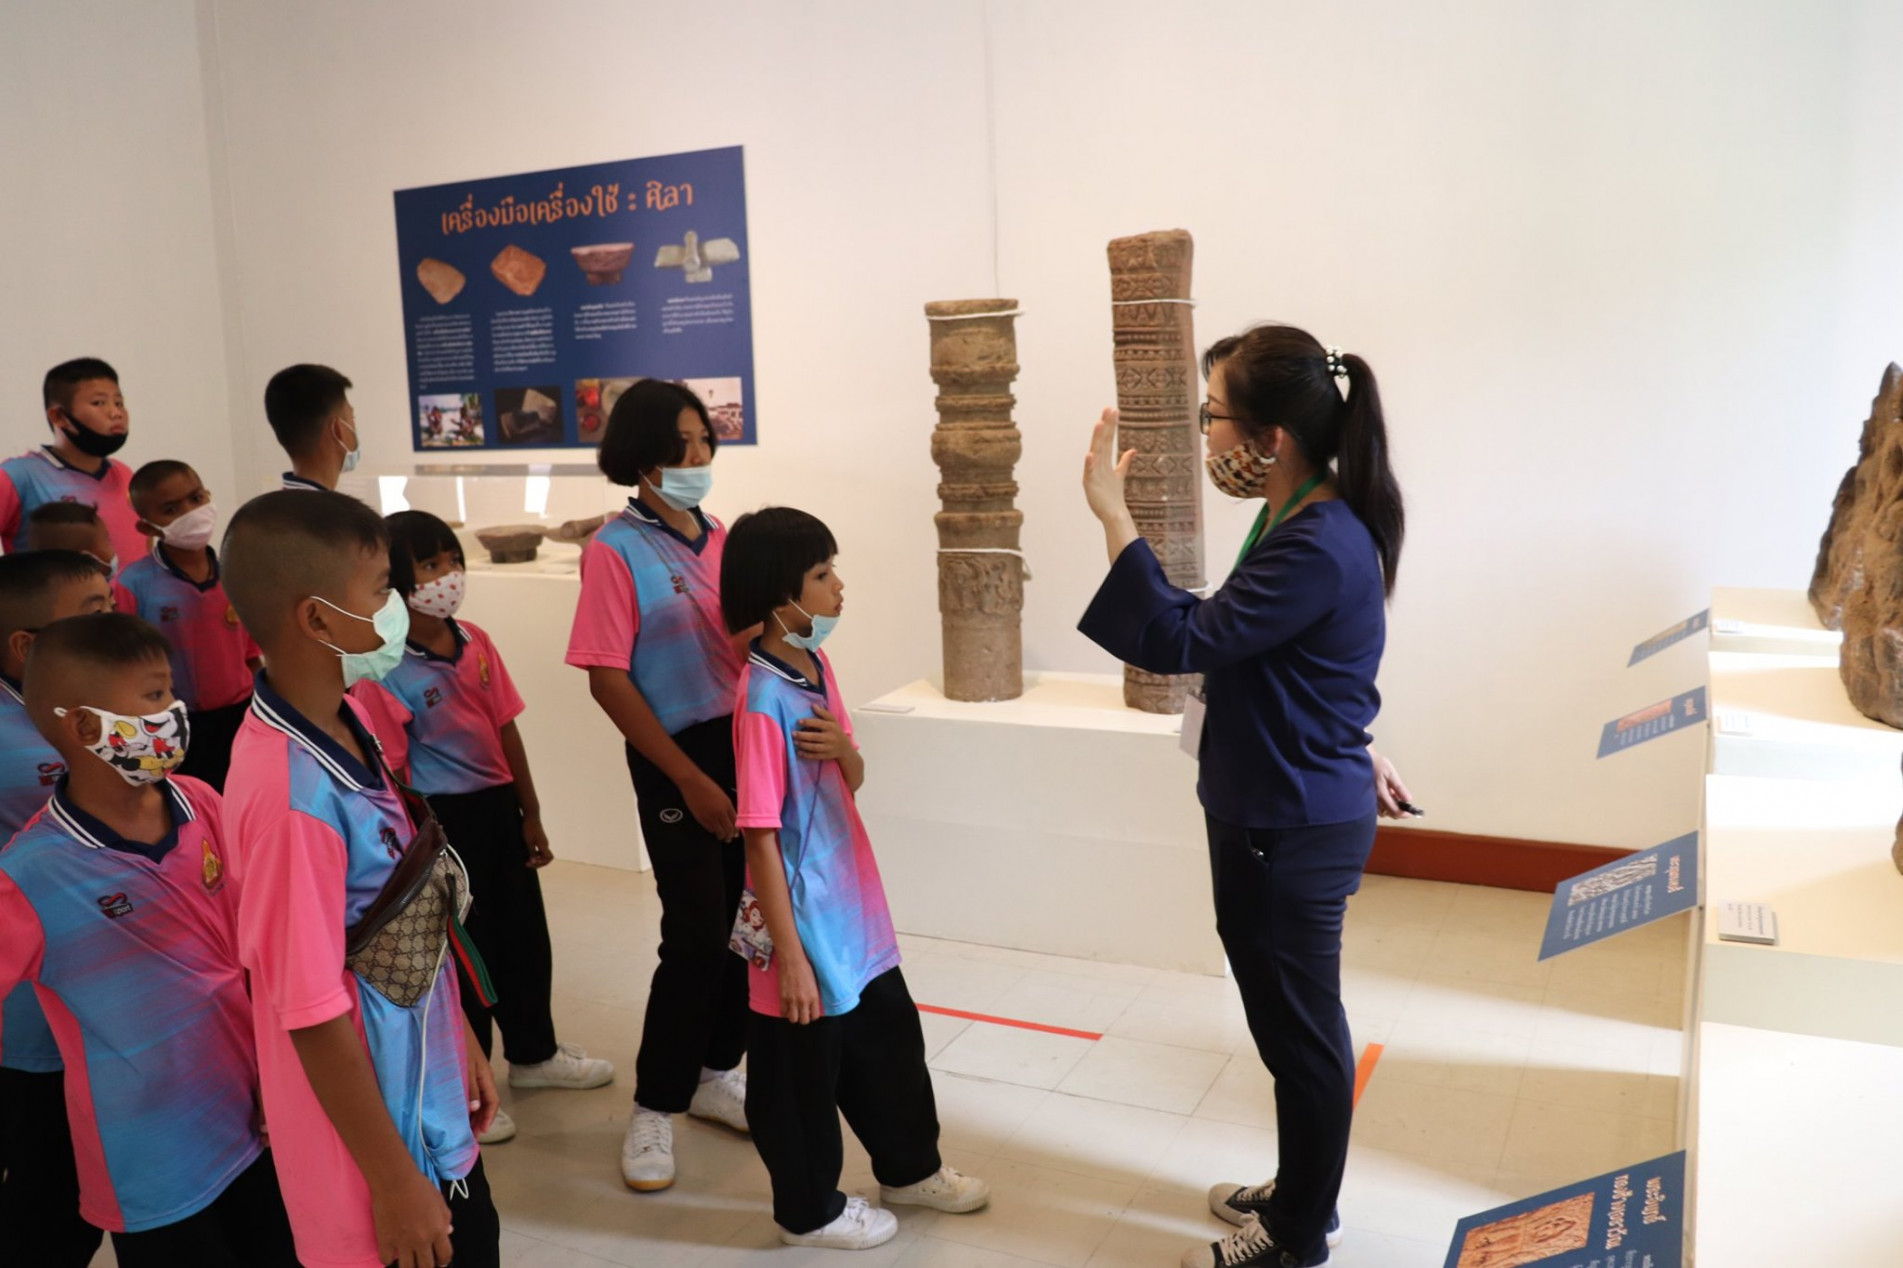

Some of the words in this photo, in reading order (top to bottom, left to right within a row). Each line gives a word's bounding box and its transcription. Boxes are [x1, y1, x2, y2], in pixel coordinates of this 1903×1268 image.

[442, 181, 620, 235] เครื่องมือเครื่องใช้
[646, 180, 693, 211] ศิลา
